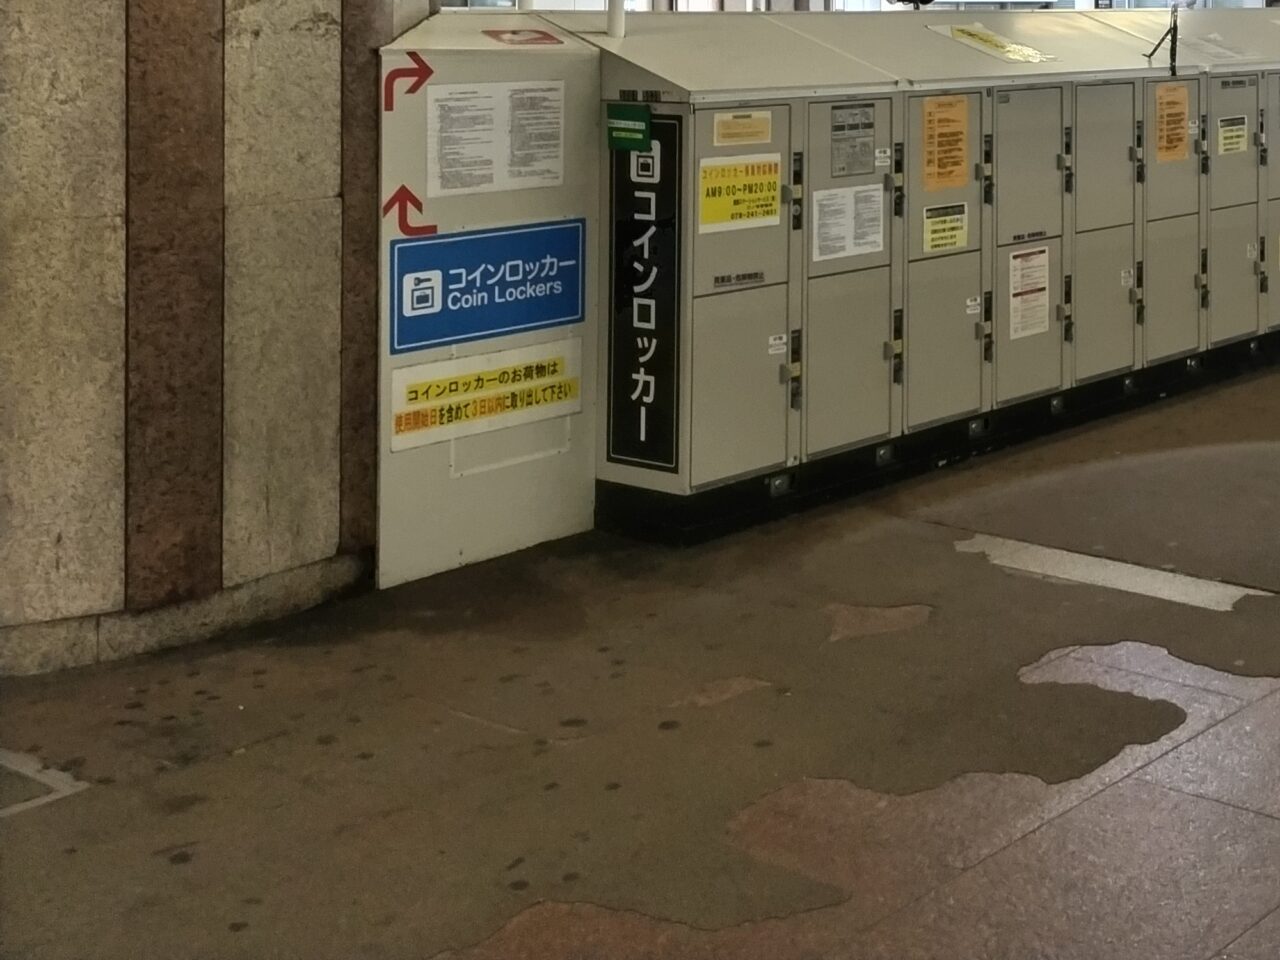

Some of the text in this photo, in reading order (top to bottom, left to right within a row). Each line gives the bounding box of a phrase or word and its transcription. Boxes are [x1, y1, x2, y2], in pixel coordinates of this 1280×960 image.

[448, 254, 576, 290] コインロッカー
[447, 279, 563, 310] Coin Lockers
[630, 190, 658, 442] コインロッカー
[407, 361, 559, 402] コインロッカーのお荷物は
